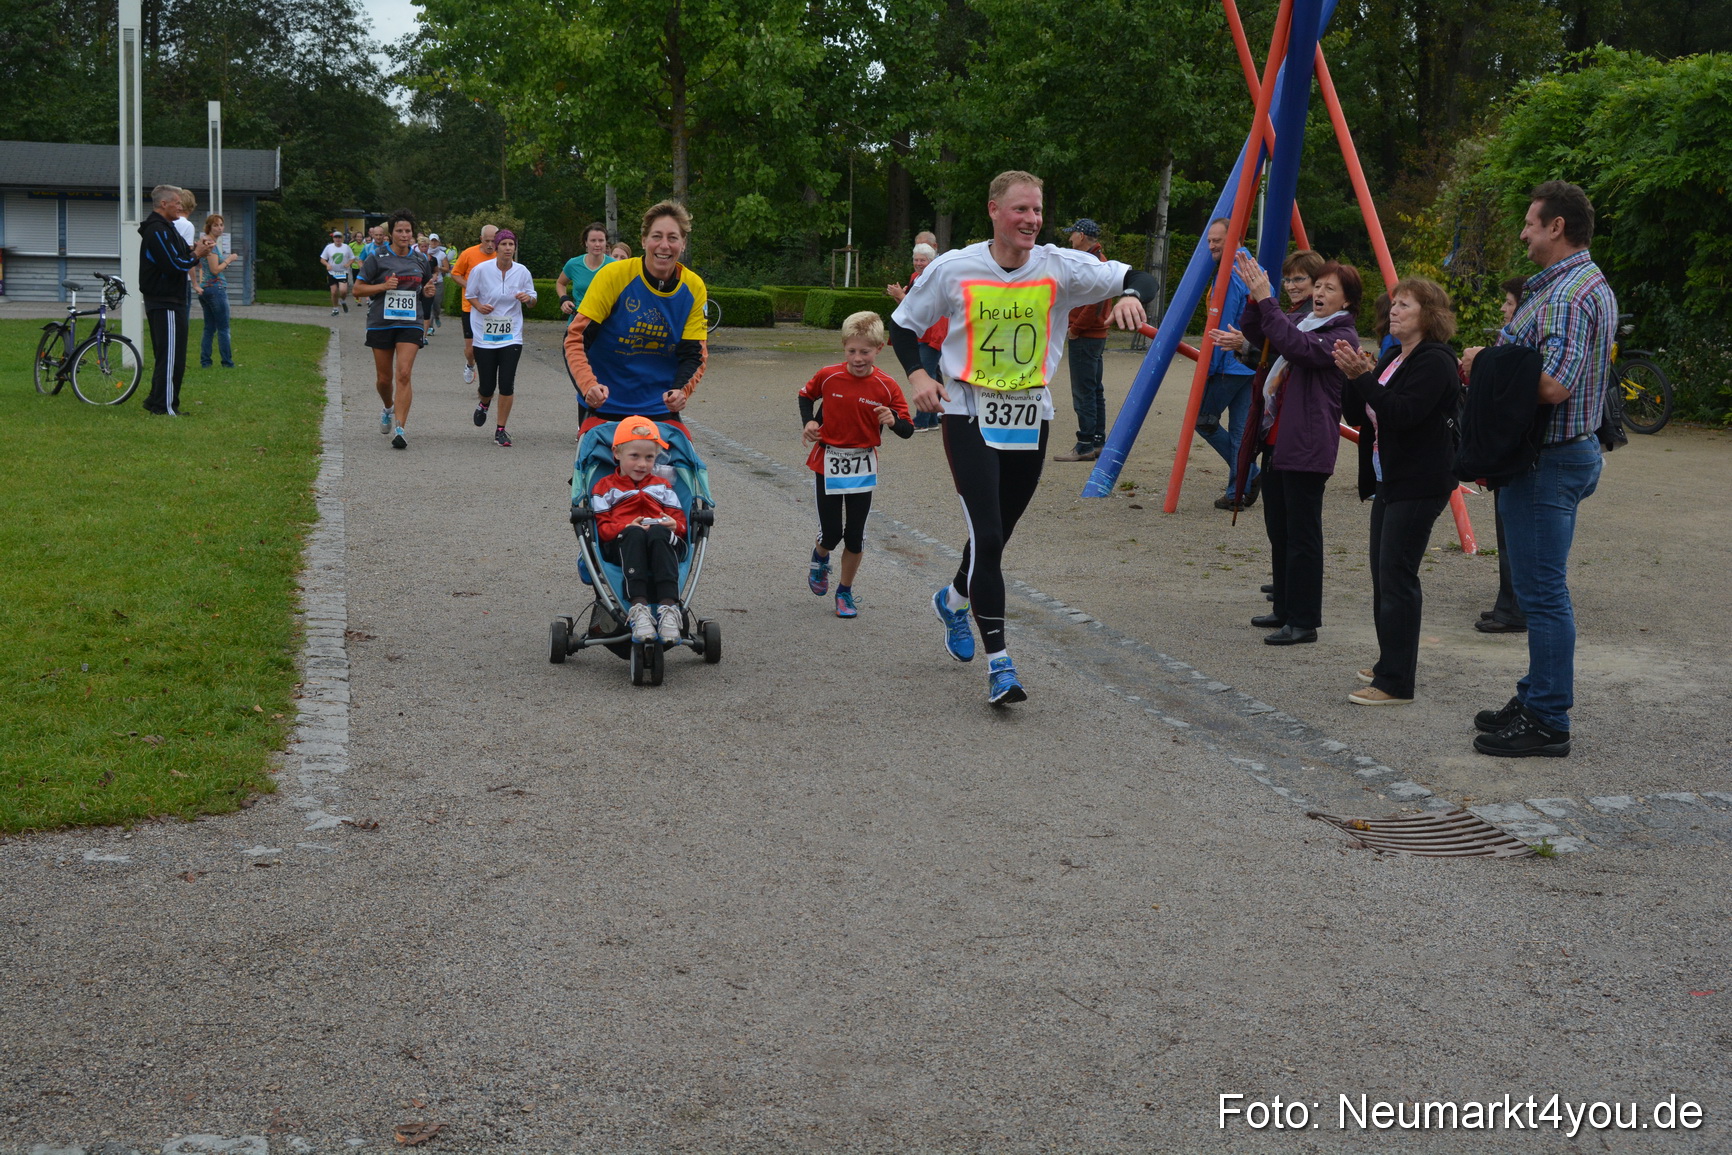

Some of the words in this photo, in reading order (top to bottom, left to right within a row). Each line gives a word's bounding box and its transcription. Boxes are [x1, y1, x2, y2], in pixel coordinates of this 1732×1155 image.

[388, 297, 414, 309] 2189
[979, 301, 1034, 320] heute
[486, 322, 511, 334] 2748
[979, 323, 1036, 367] 40
[985, 401, 1037, 426] 3370
[829, 455, 872, 475] 3371
